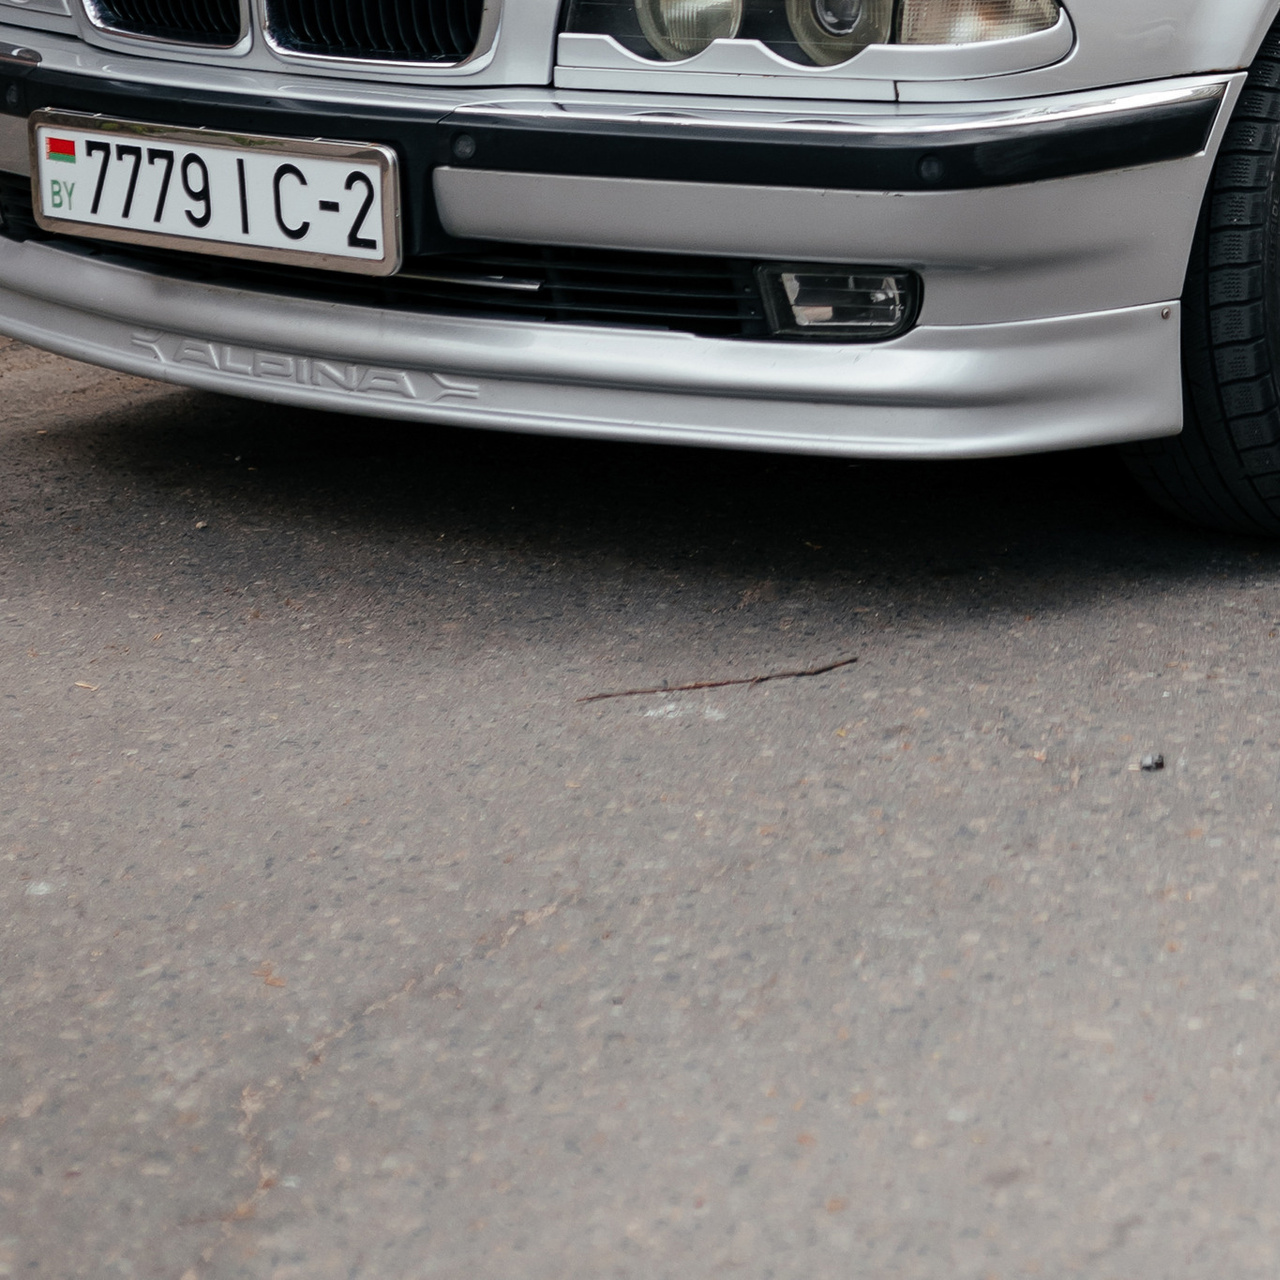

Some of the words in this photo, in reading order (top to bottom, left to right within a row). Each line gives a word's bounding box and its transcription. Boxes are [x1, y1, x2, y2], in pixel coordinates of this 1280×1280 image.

[50, 178, 76, 211] BY
[84, 139, 212, 229] 7779
[172, 340, 419, 400] ALPINA
